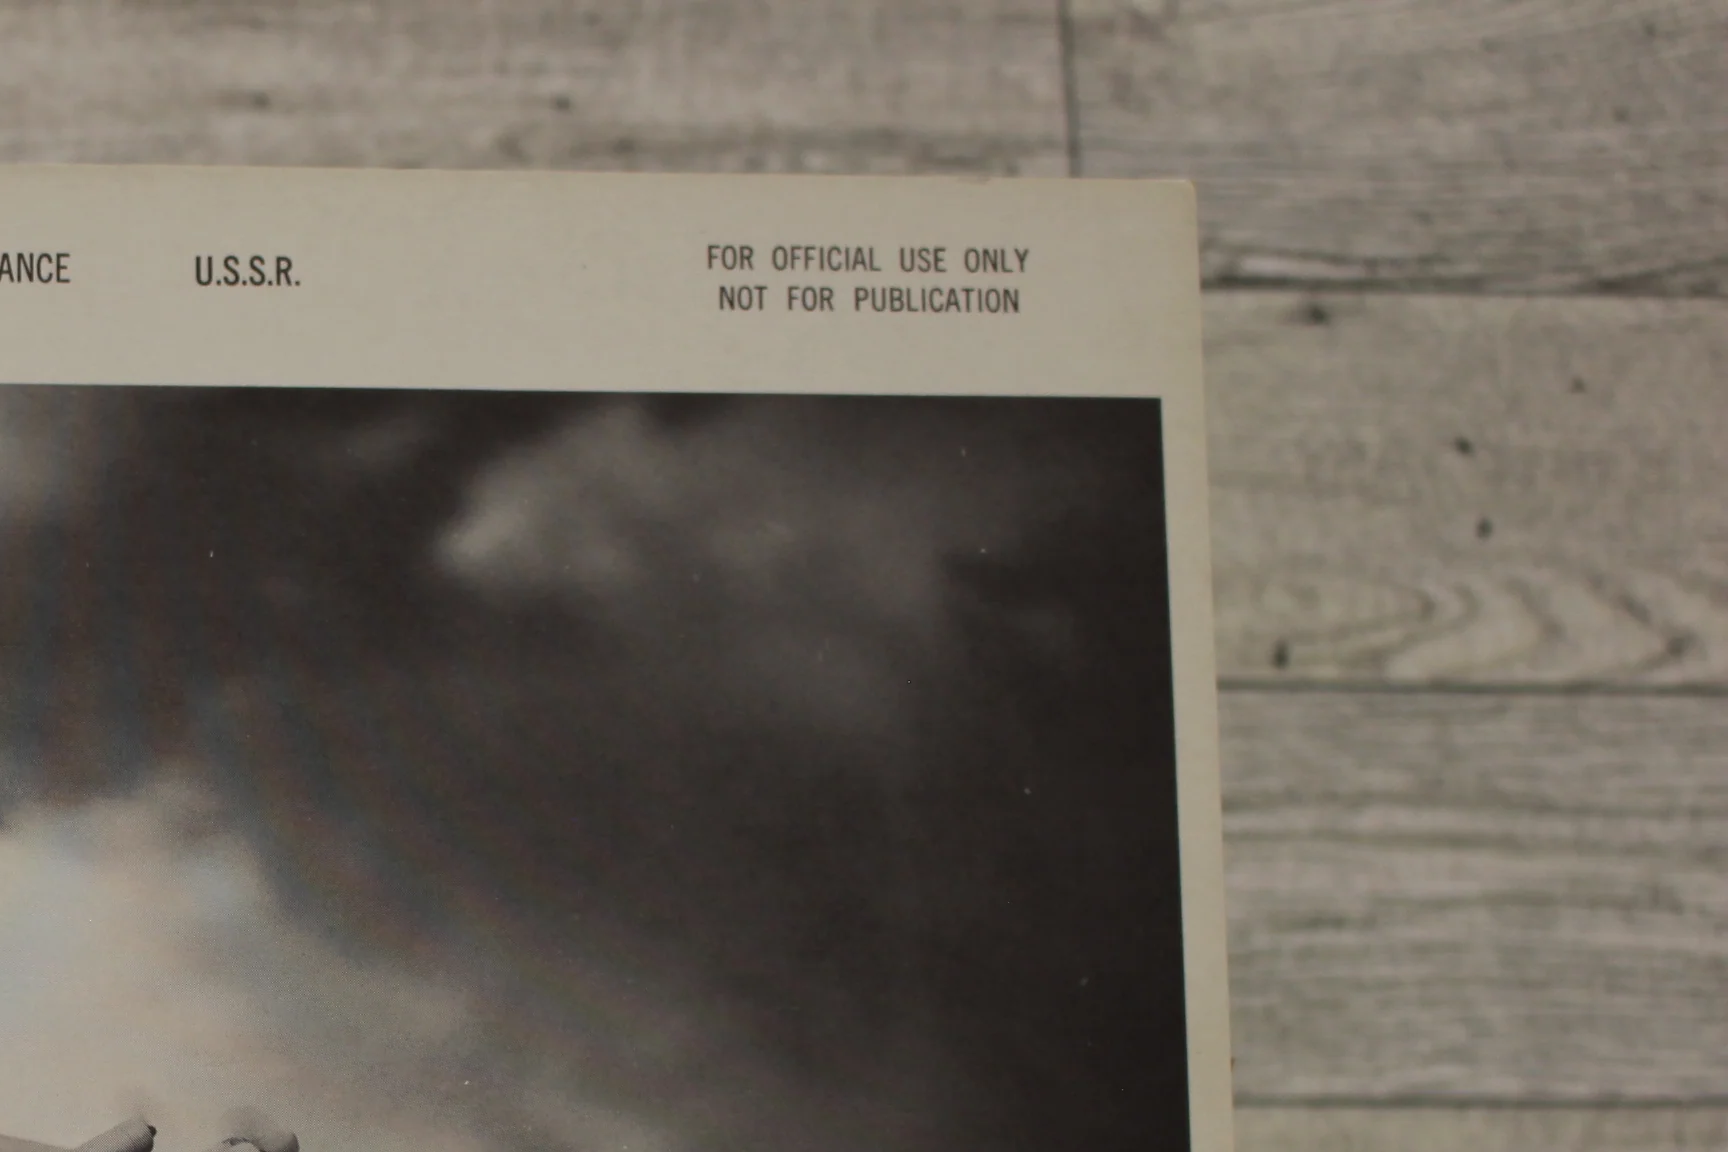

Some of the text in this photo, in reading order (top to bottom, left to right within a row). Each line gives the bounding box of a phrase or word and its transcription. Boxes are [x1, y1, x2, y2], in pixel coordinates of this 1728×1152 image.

[195, 255, 302, 287] U.S.S.R.
[707, 244, 1029, 274] FOR OFFICIAL USE ONLY
[719, 285, 1020, 314] NOT FOR PUBLICATION
